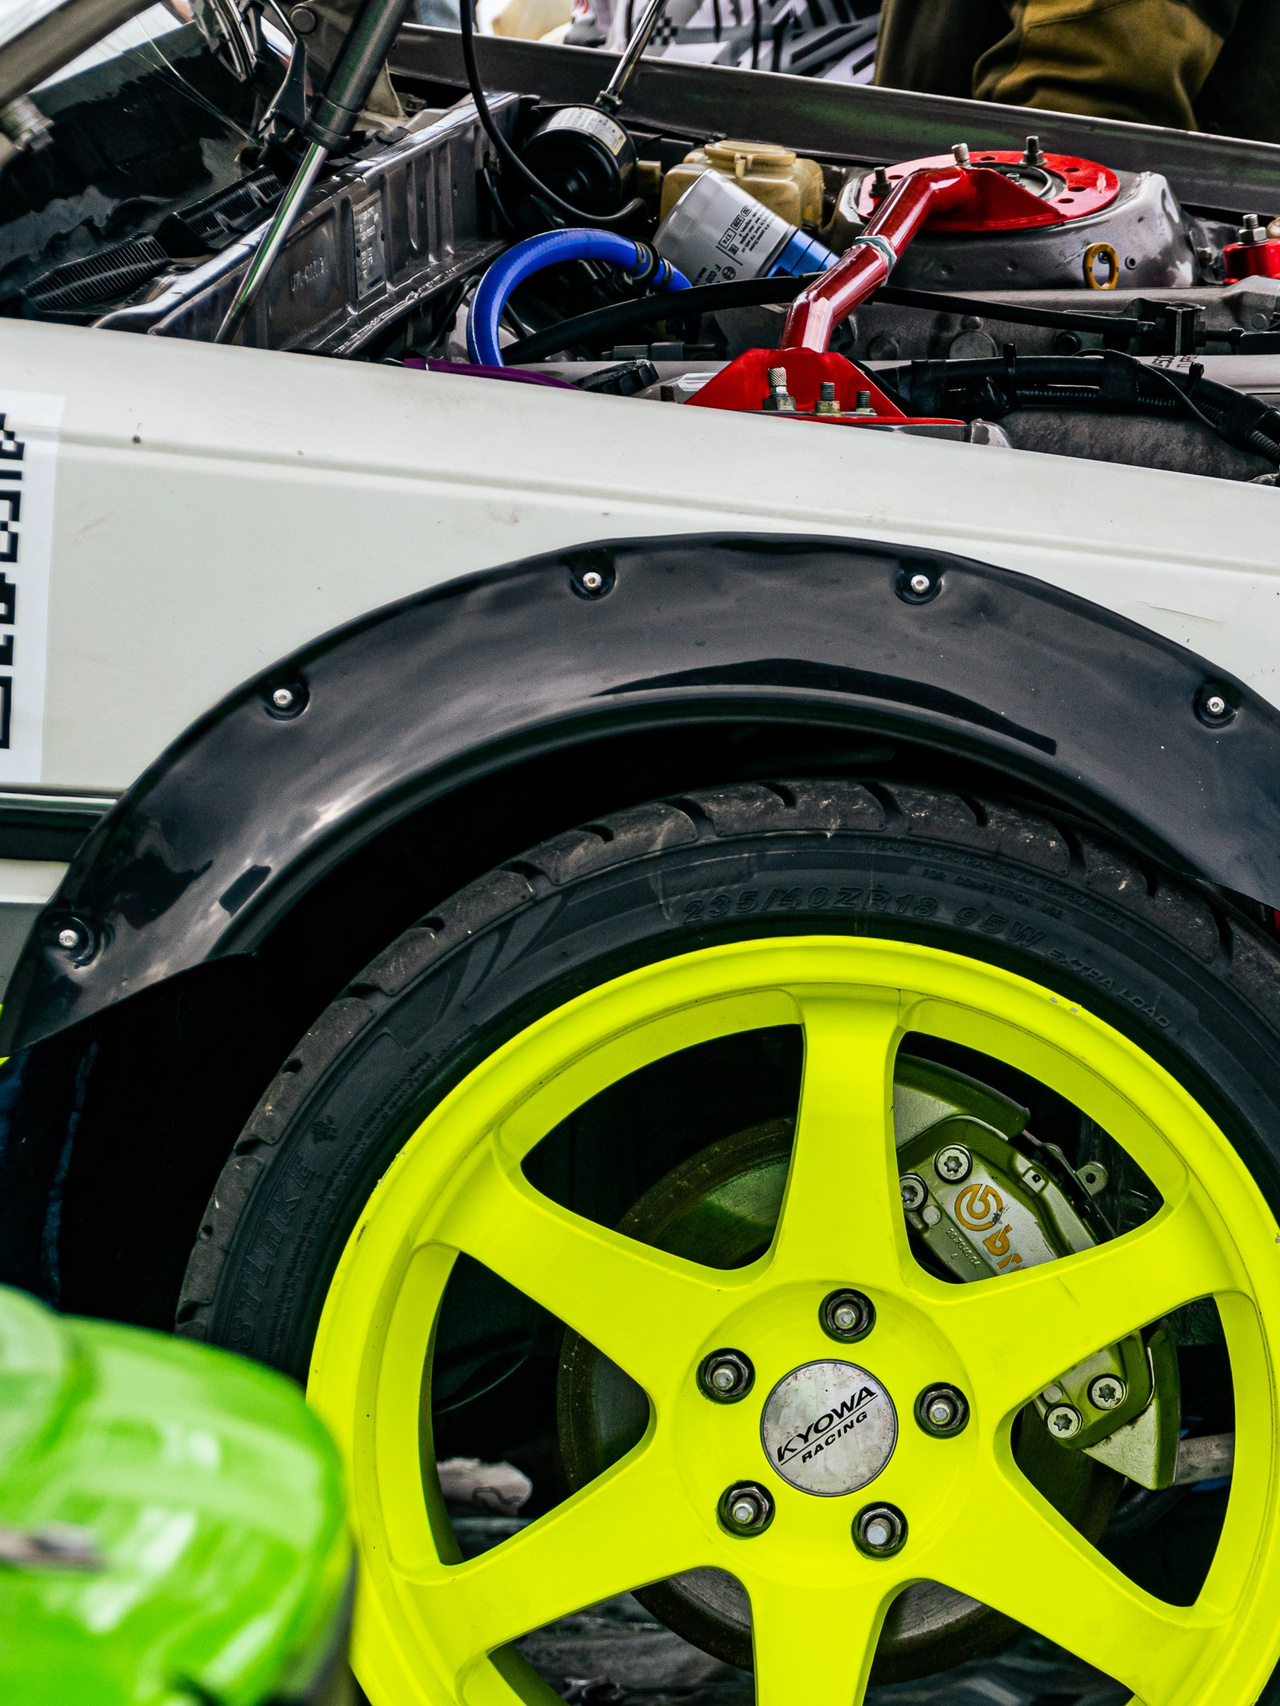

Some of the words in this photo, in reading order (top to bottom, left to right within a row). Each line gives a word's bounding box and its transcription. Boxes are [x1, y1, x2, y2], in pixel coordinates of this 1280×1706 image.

[921, 868, 946, 881] FOR
[954, 874, 1034, 907] COMPETITION
[1038, 901, 1064, 919] USE
[681, 884, 940, 925] 235/40ZR18
[954, 906, 1046, 948] 95W
[1046, 947, 1116, 990] EXTRA
[1117, 988, 1173, 1030] LOAD
[230, 1152, 315, 1349] STLAKE
[777, 1386, 876, 1462] KYOWA
[802, 1411, 867, 1464] RACING
